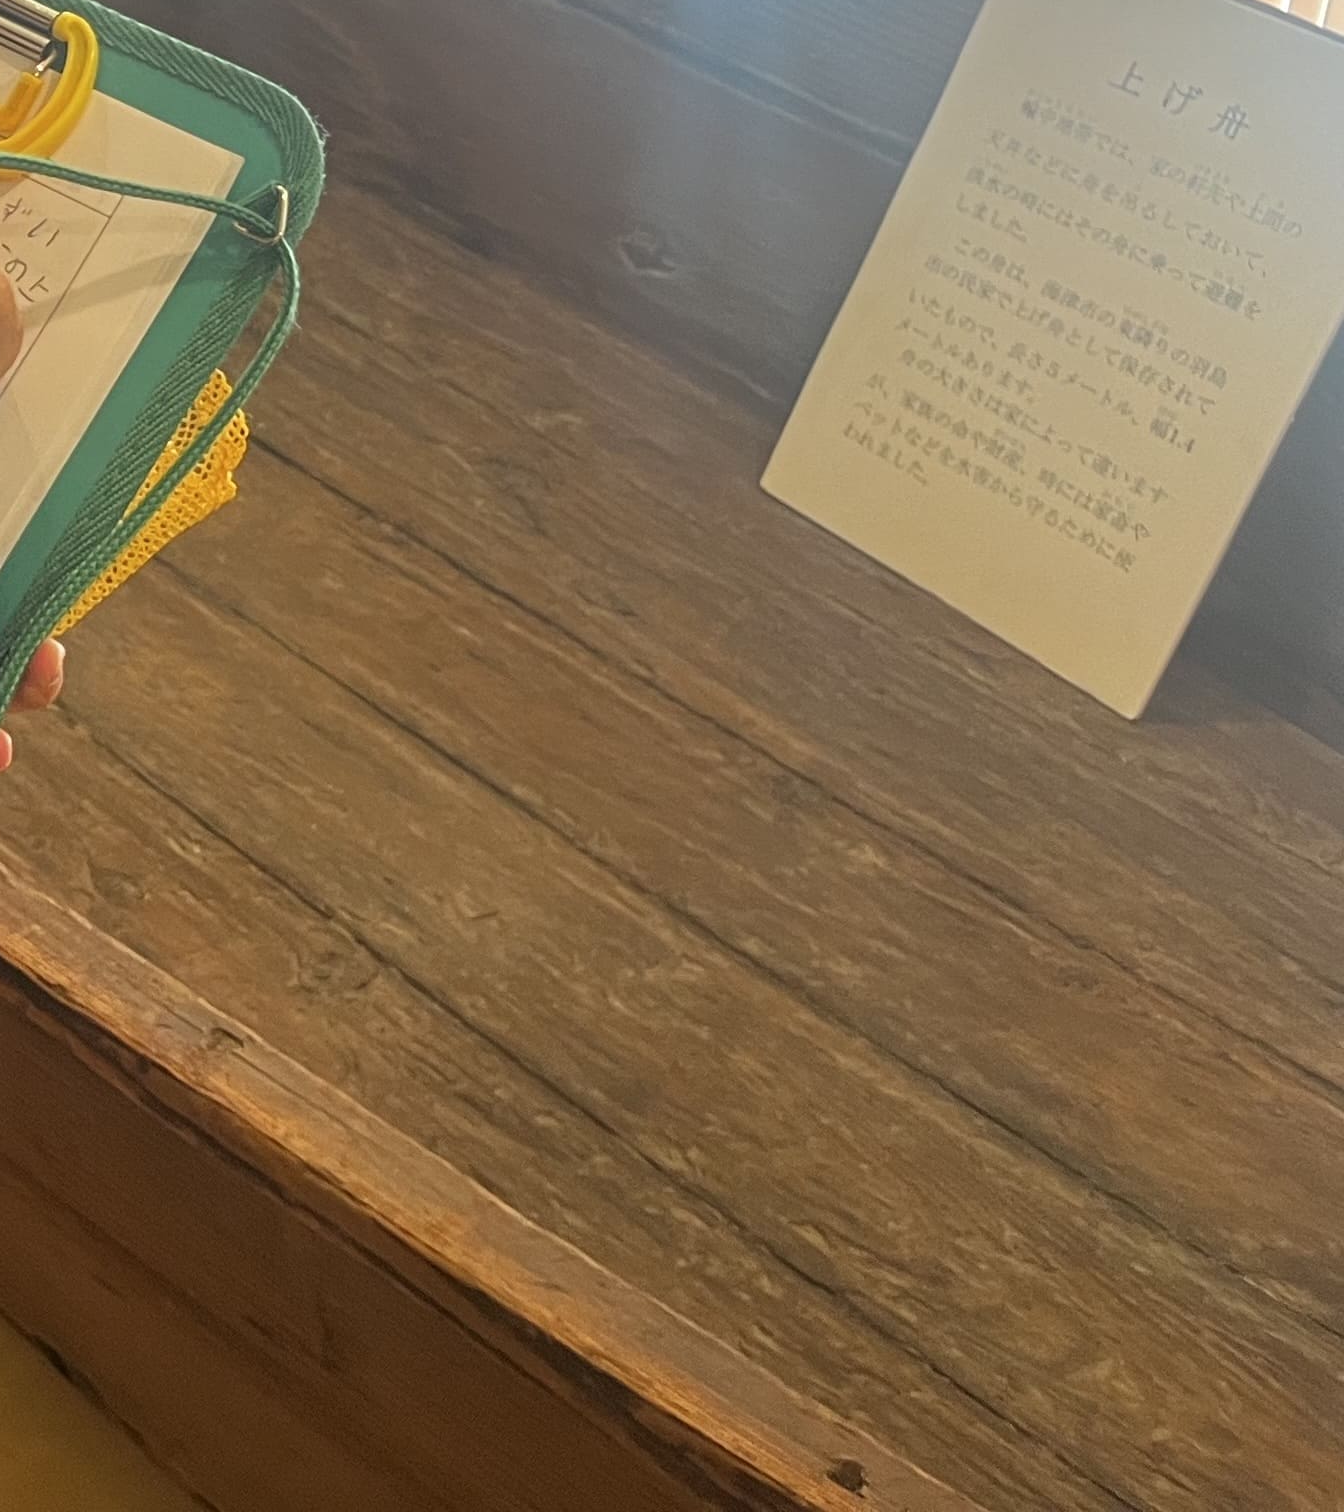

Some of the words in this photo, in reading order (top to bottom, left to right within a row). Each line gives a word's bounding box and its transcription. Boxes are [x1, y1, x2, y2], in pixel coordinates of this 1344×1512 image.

[1104, 54, 1258, 145] 上げ舟
[952, 190, 1033, 244] しました。
[839, 420, 934, 488] われました。
